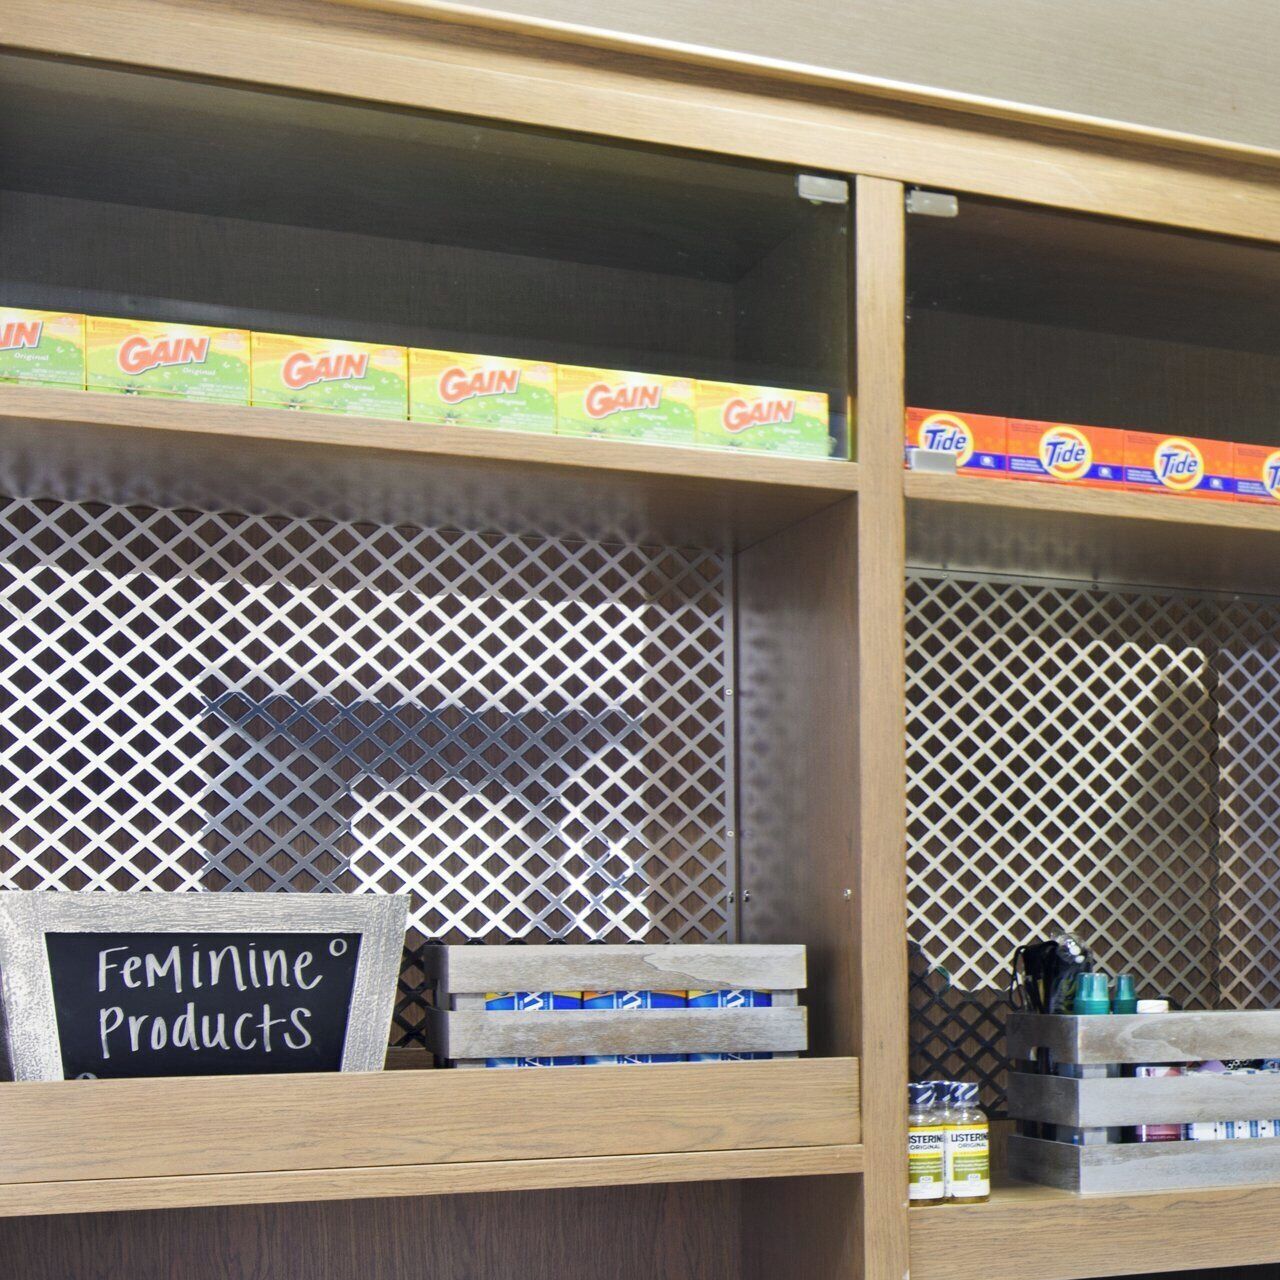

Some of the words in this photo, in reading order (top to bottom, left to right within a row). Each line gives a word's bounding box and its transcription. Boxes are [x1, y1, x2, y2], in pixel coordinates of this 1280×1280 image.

[117, 335, 210, 375] GAIN
[282, 352, 369, 391] GAIN
[438, 367, 521, 404] GAIN
[585, 383, 662, 419] GAIN
[722, 398, 796, 433] GAIN
[925, 428, 967, 452] Tide
[1046, 440, 1086, 468] Tide
[1160, 452, 1198, 478] Tide
[99, 1001, 312, 1059] Products
